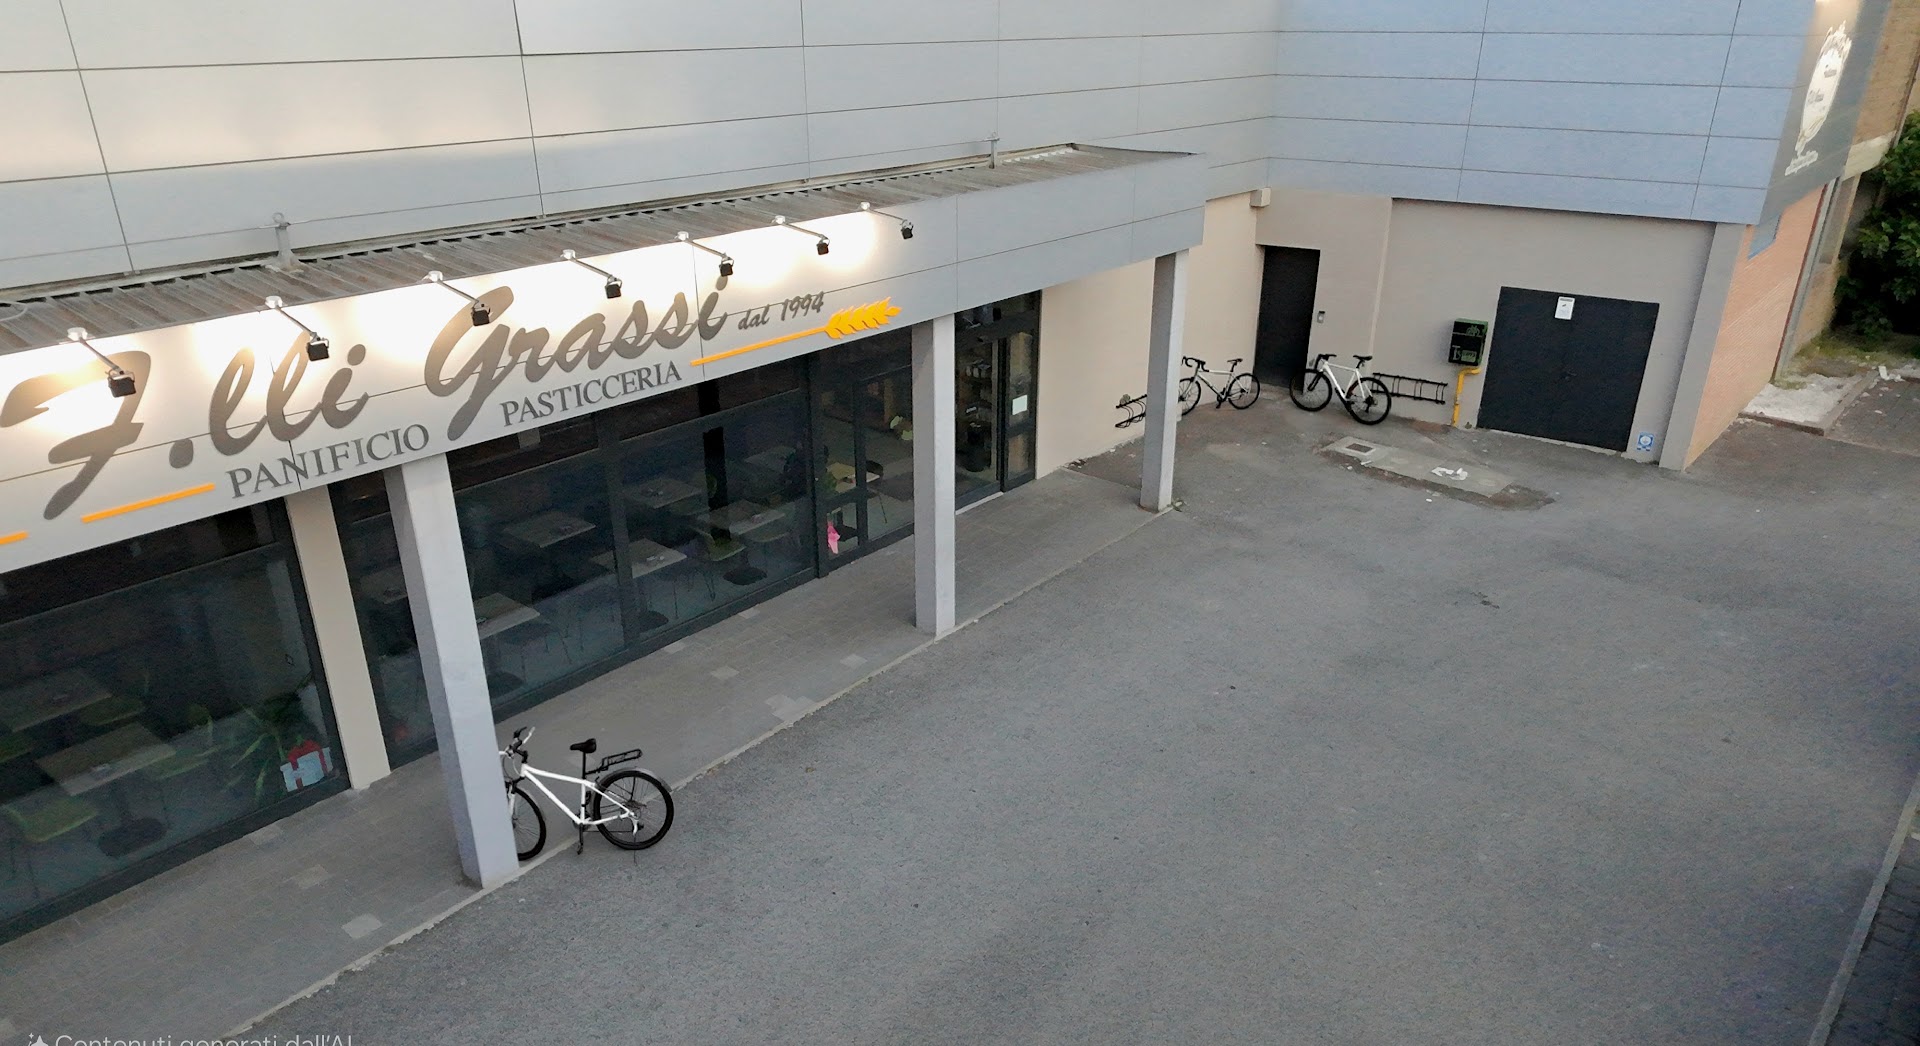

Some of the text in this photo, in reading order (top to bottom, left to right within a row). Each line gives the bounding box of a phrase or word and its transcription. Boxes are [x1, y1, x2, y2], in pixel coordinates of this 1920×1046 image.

[737, 290, 825, 331] dal 1994
[0, 275, 728, 520] F.lli Grassi
[225, 360, 683, 499] PANIFICIO PASTICCERIA
